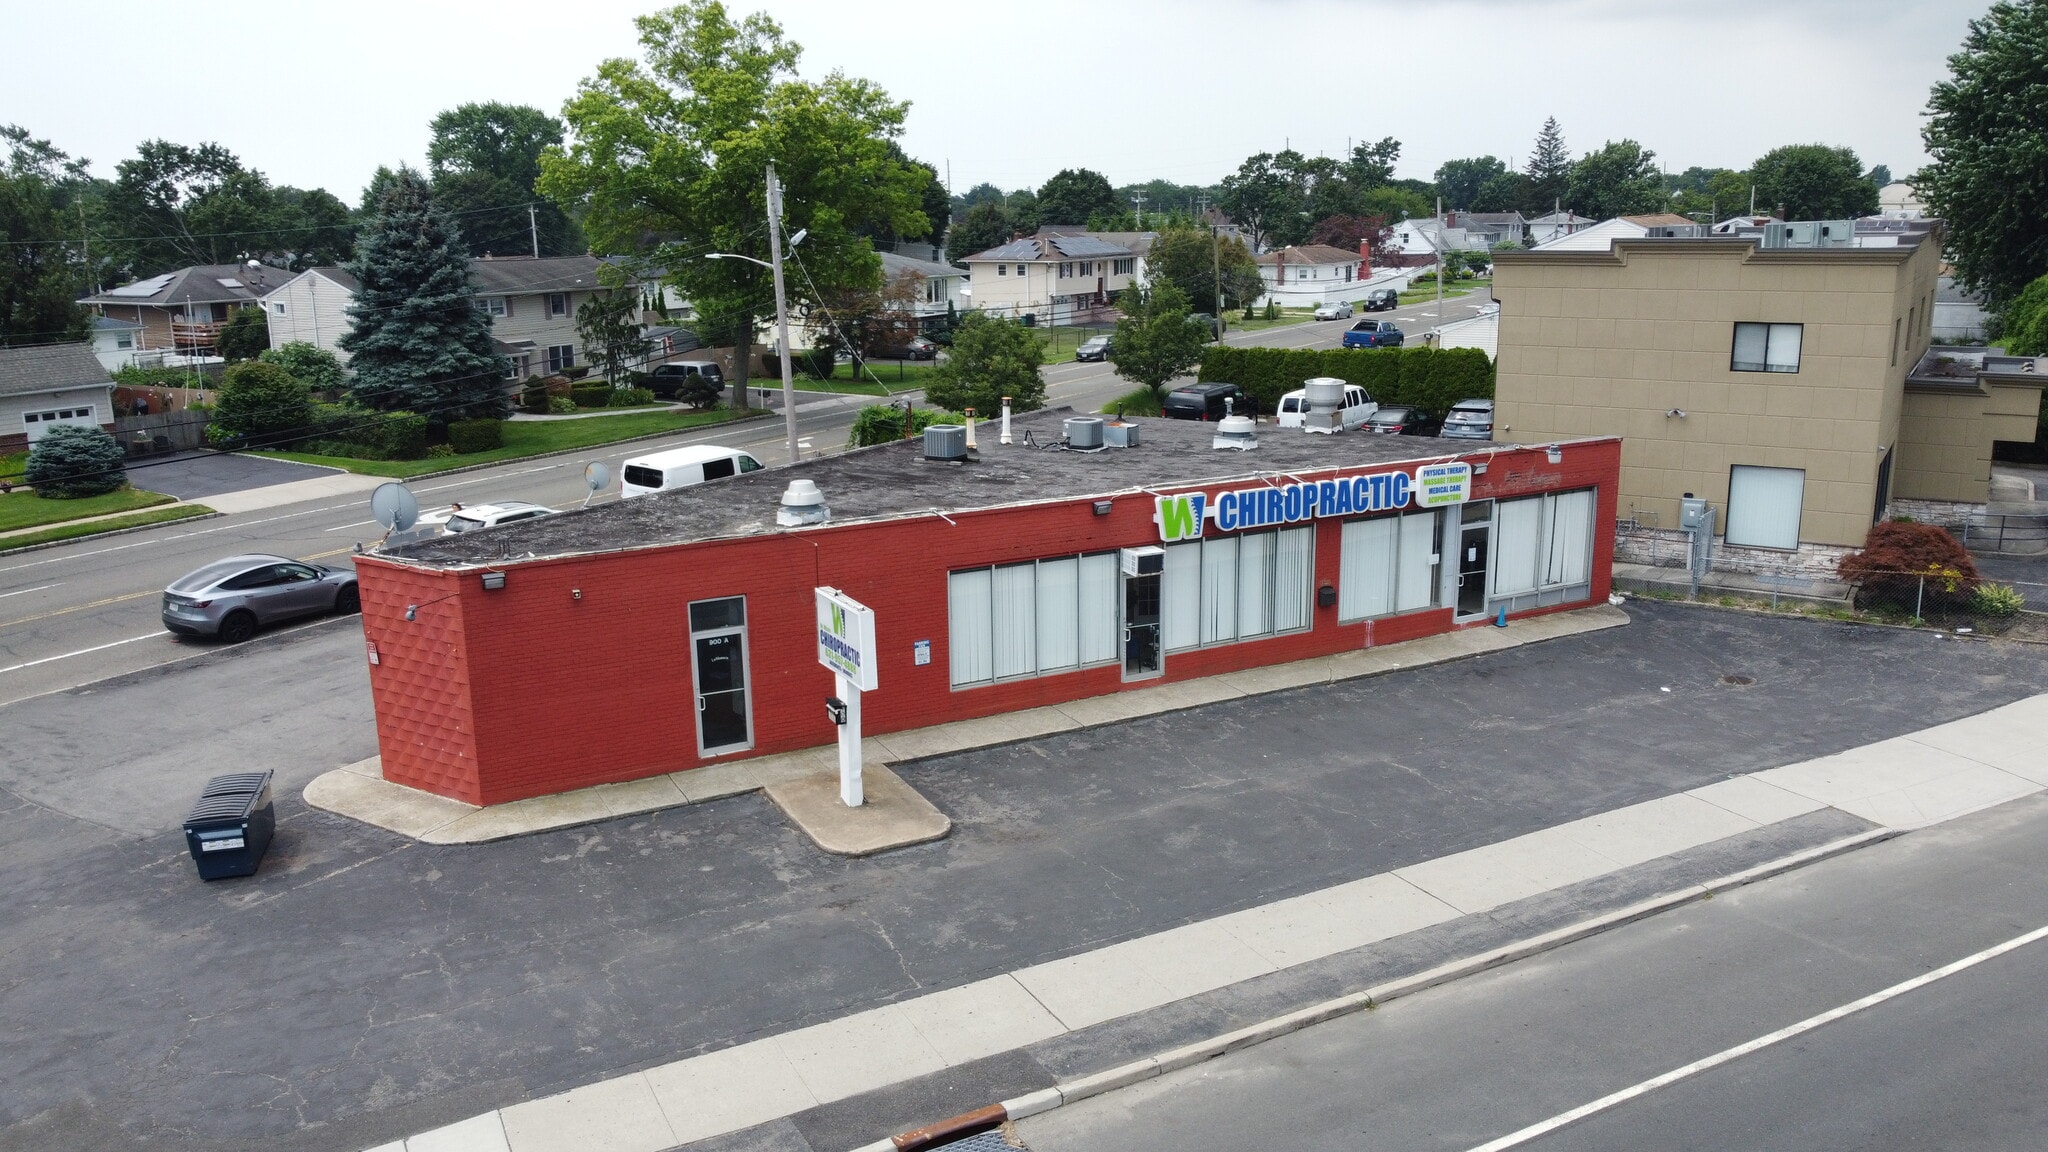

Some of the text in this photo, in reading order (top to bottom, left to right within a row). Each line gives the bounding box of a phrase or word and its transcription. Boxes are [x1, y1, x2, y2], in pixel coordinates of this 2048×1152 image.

[1424, 466, 1467, 477] PHYSICAL THERAPY
[1447, 475, 1466, 483] THERAPY
[1429, 484, 1461, 494] MEDICAL CARE
[1219, 473, 1409, 531] CHIROPRACTIC
[820, 629, 861, 668] CHIROPRACTIC
